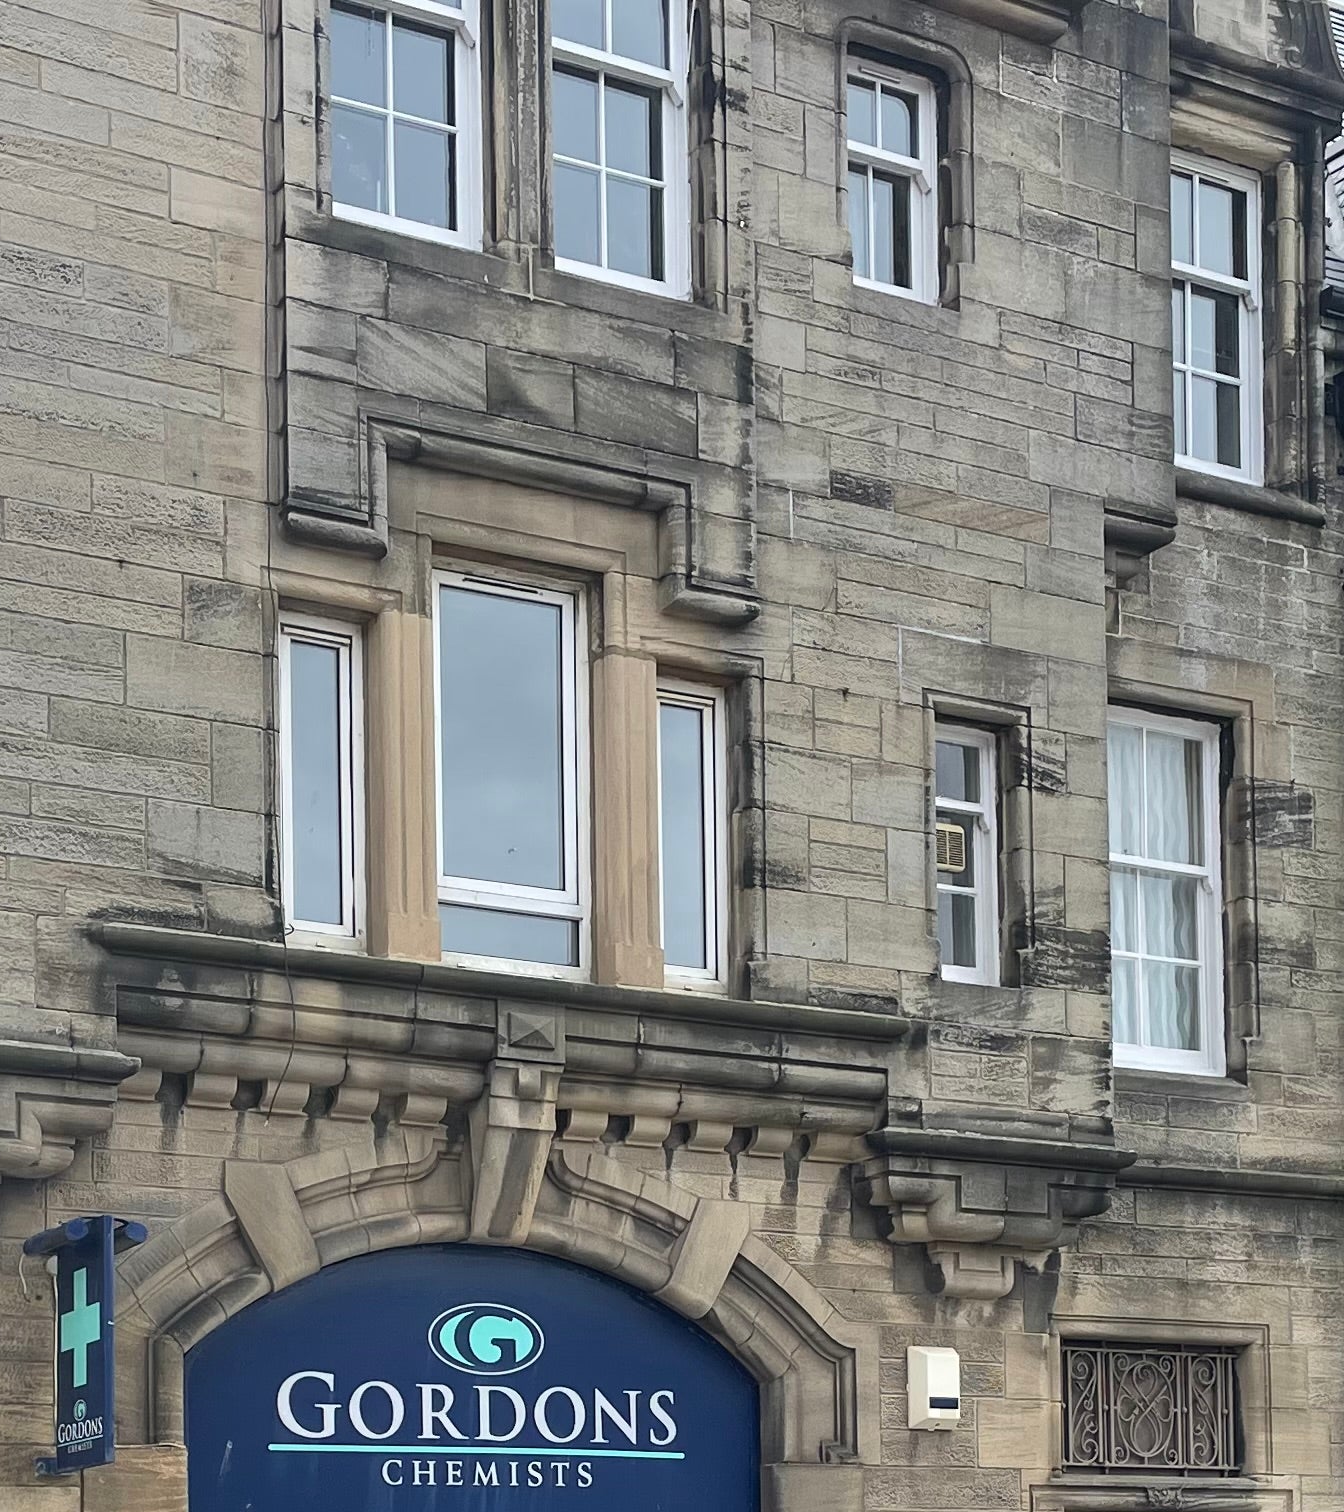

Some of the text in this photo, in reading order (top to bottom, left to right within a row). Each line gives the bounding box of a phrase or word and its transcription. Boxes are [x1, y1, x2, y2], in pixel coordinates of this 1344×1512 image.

[276, 1370, 678, 1446] GORDONS
[57, 1416, 103, 1443] GORDONS
[381, 1458, 593, 1488] CHEMISTS
